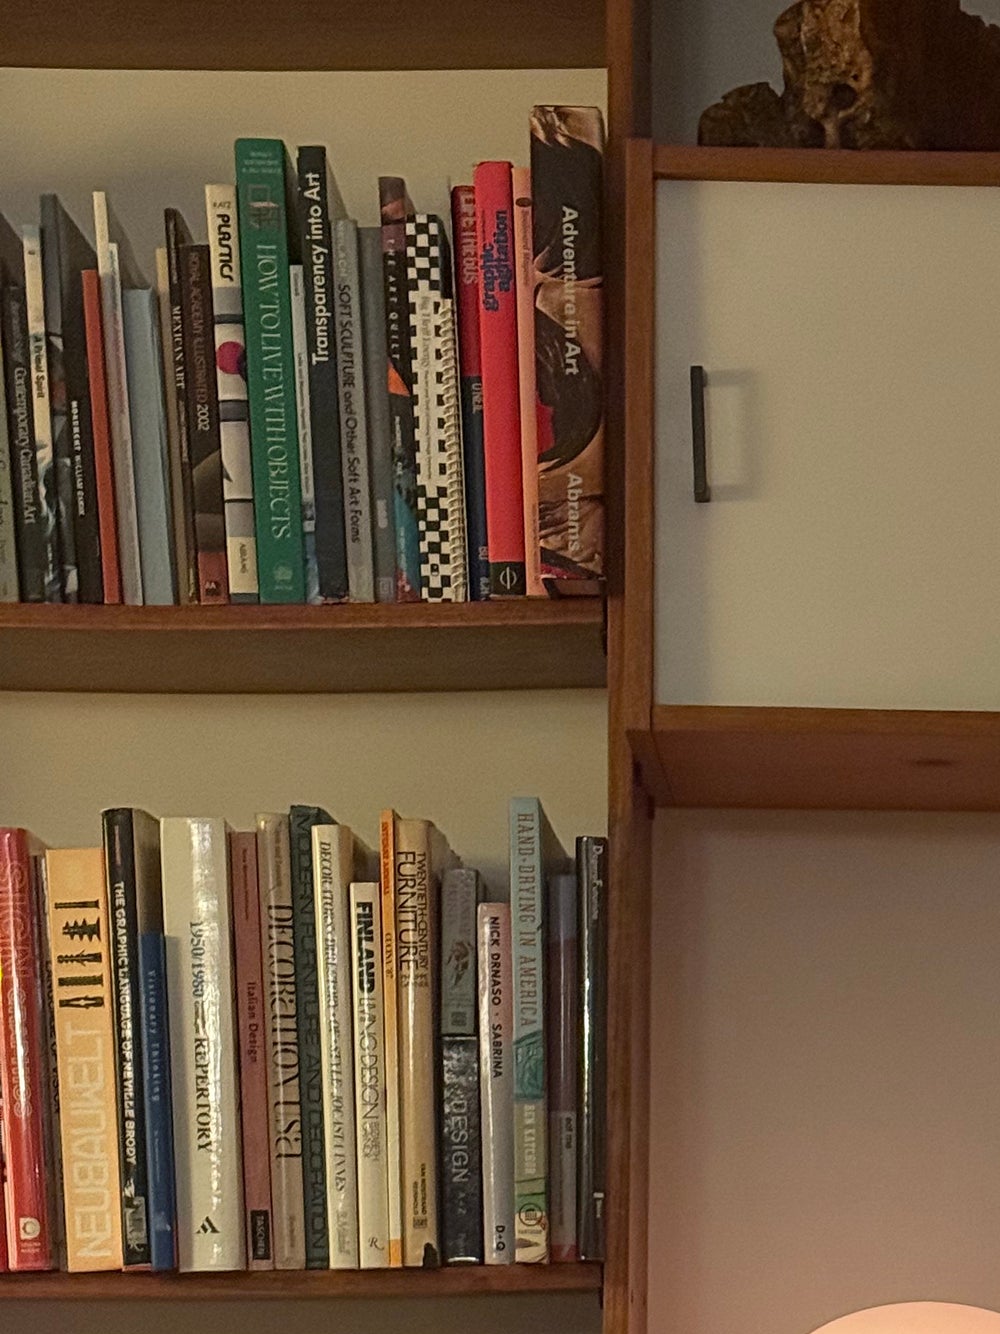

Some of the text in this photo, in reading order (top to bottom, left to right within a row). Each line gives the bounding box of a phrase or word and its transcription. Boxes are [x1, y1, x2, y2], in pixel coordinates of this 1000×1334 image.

[216, 213, 235, 283] PLASTICS
[303, 172, 332, 367] Transparency into Art
[387, 238, 401, 360] THE ART QUILT
[561, 205, 582, 376] Adventure in Art
[171, 305, 186, 389] MEXICAN ART
[13, 367, 30, 447] Contemporary
[35, 375, 47, 400] Spirit
[196, 404, 210, 431] 2002
[256, 244, 293, 541] HOW TO LIVE WITH OBJECTS
[337, 283, 364, 545] SOFT SCULPTURE and Other Soft Art Forms
[20, 449, 35, 504] Canadian
[23, 504, 37, 524] Art
[565, 472, 584, 553] Abrams
[239, 542, 250, 575] ABRAMS
[114, 881, 126, 907] THE
[397, 850, 419, 972] FURNITURE
[115, 908, 129, 965] GRAPHIC
[189, 920, 206, 998] 1950/1980
[519, 930, 537, 947] IN
[117, 967, 133, 1038] LANGUAGE
[247, 981, 259, 1019] Italian
[356, 901, 380, 1119] FINLAND LIVING DESIGN
[489, 916, 503, 1078] NICK DRNASO SABRINA
[519, 955, 538, 1028] AMERICA
[121, 1040, 133, 1060] OF
[148, 970, 162, 1102] Visionary Thinking
[247, 1022, 260, 1063] Design
[297, 813, 327, 1250] MODERN FURNITURE AND DECORATION
[122, 1061, 135, 1119] NEVILLE
[194, 1037, 213, 1153] REPERTORY
[64, 1021, 113, 1257] NEUBAUWELT
[125, 1120, 137, 1166] BRODY
[450, 1099, 471, 1183] DESIGN
